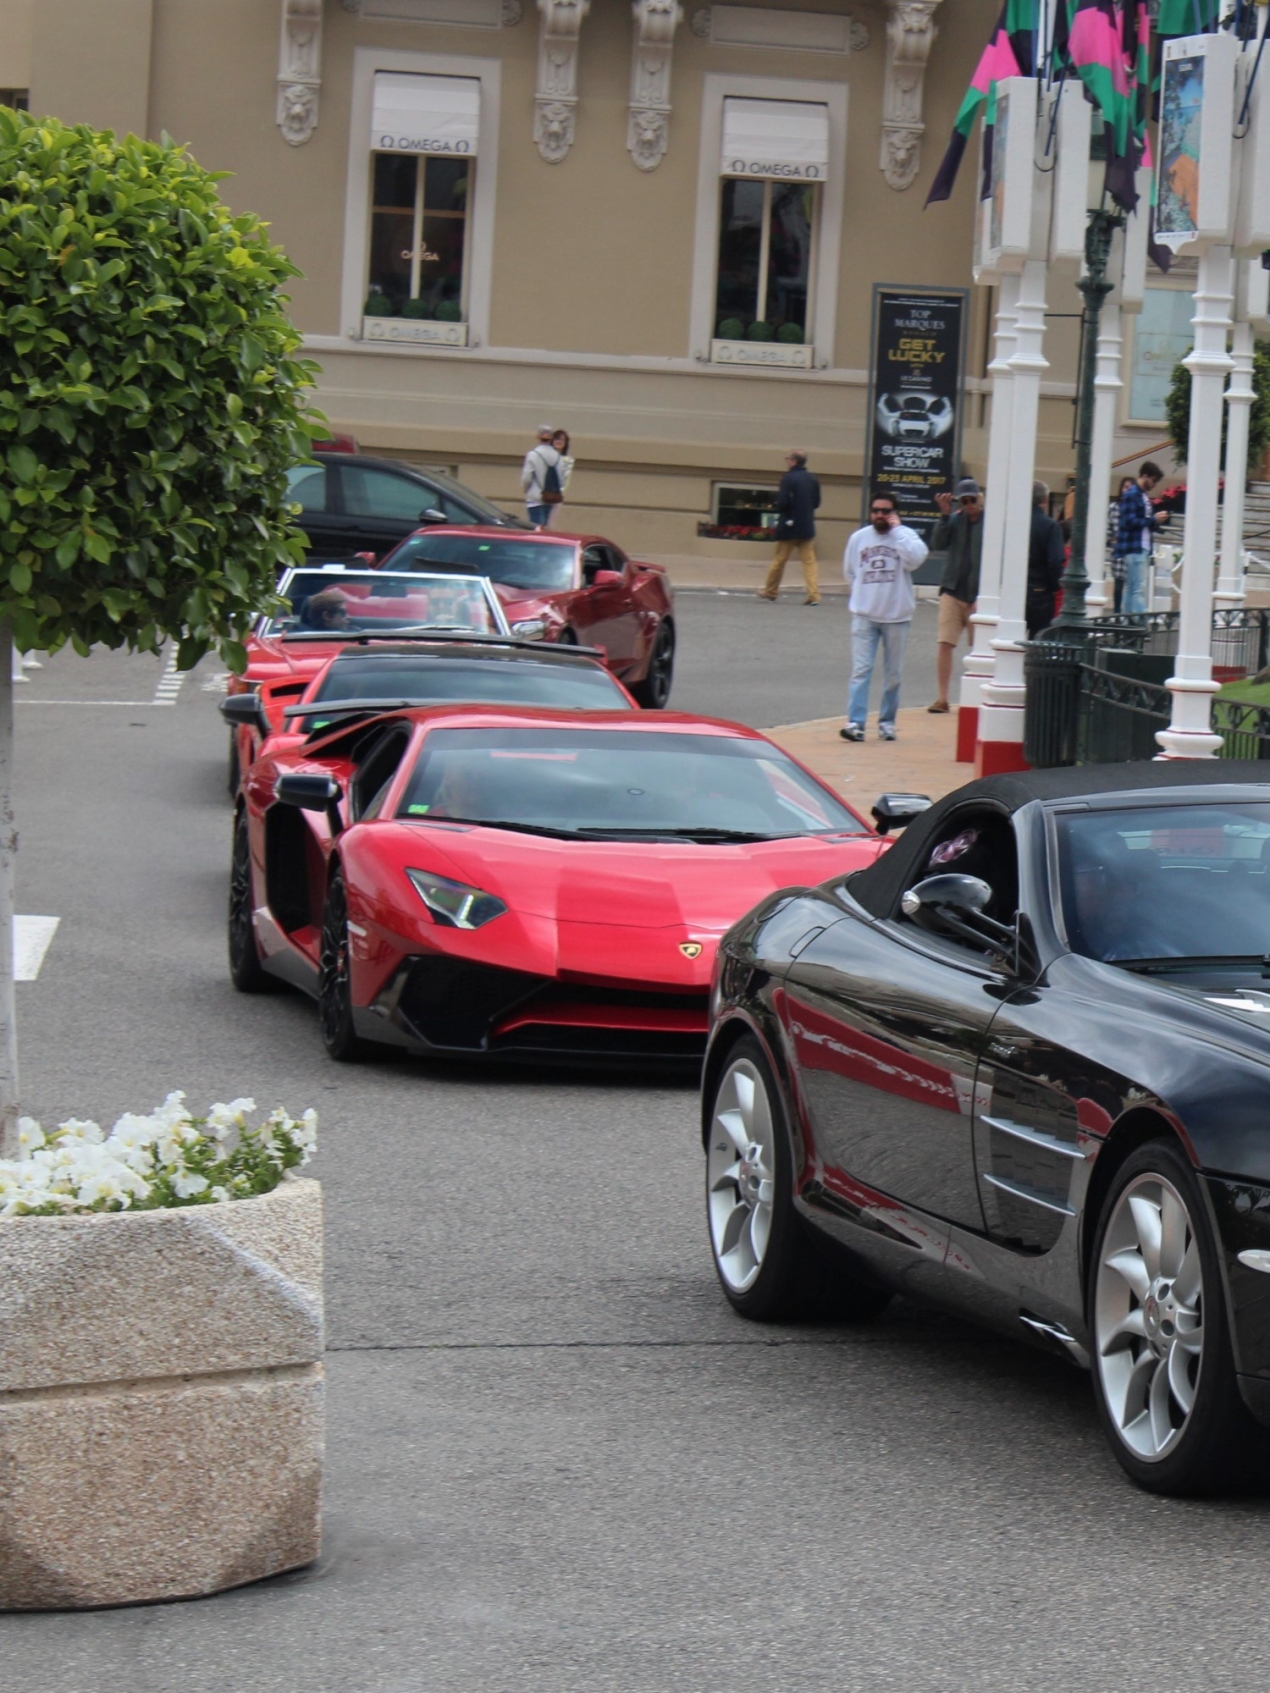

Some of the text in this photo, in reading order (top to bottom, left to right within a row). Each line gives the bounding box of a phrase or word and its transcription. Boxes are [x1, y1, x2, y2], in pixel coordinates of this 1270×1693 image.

[398, 137, 452, 152] OMEGA
[749, 162, 802, 177] OMEGA
[910, 309, 932, 319] TOP
[894, 318, 945, 331] MARQUES
[899, 338, 936, 351] GET
[888, 349, 946, 363] LUCKY
[881, 445, 944, 458] SUPERCAR
[893, 456, 931, 468] SHOW
[901, 475, 925, 484] APRIL
